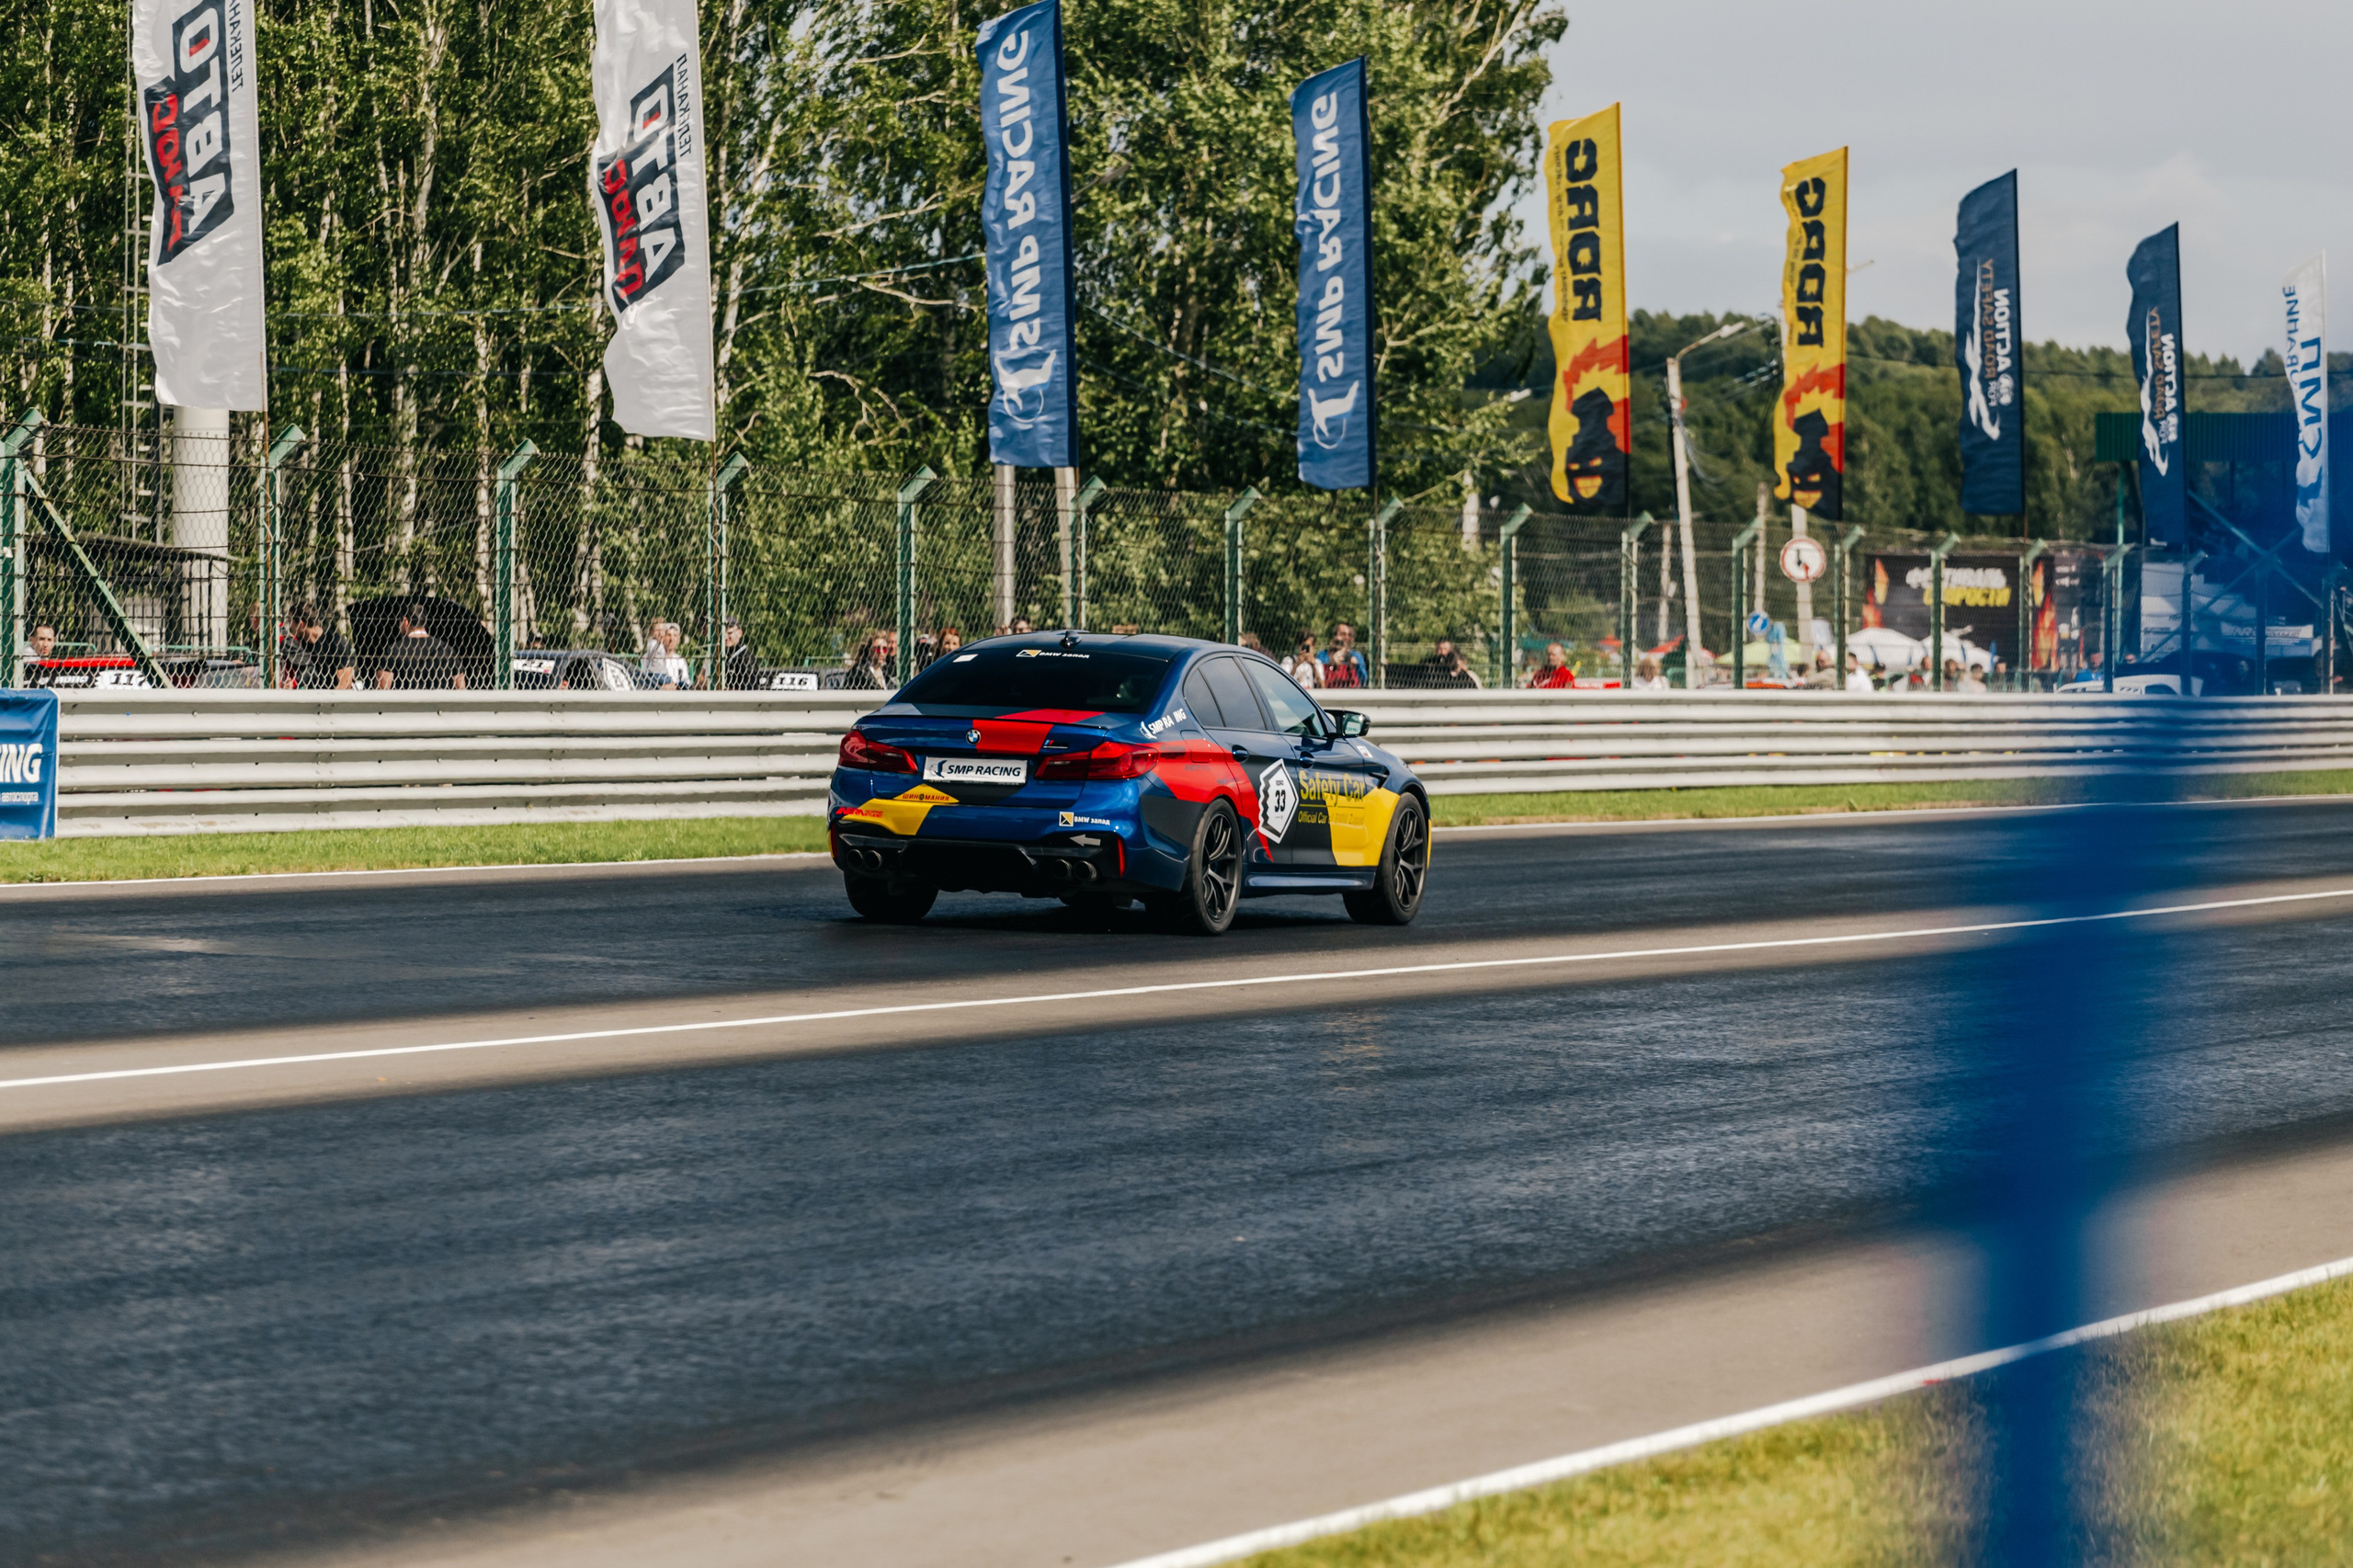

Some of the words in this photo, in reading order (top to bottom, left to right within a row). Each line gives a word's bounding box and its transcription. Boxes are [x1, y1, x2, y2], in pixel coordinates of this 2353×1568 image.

[1148, 719, 1165, 734] SMP
[1162, 708, 1187, 728] RAING
[0, 743, 43, 783] ING
[947, 765, 973, 774] SMP
[975, 766, 1021, 777] RACING
[902, 793, 949, 801] ШИНОМАНИЯ
[1298, 769, 1340, 807] Safety
[1343, 773, 1365, 801] Car
[1275, 790, 1286, 812] 33
[1298, 811, 1317, 824] Official
[1318, 812, 1327, 824] Car
